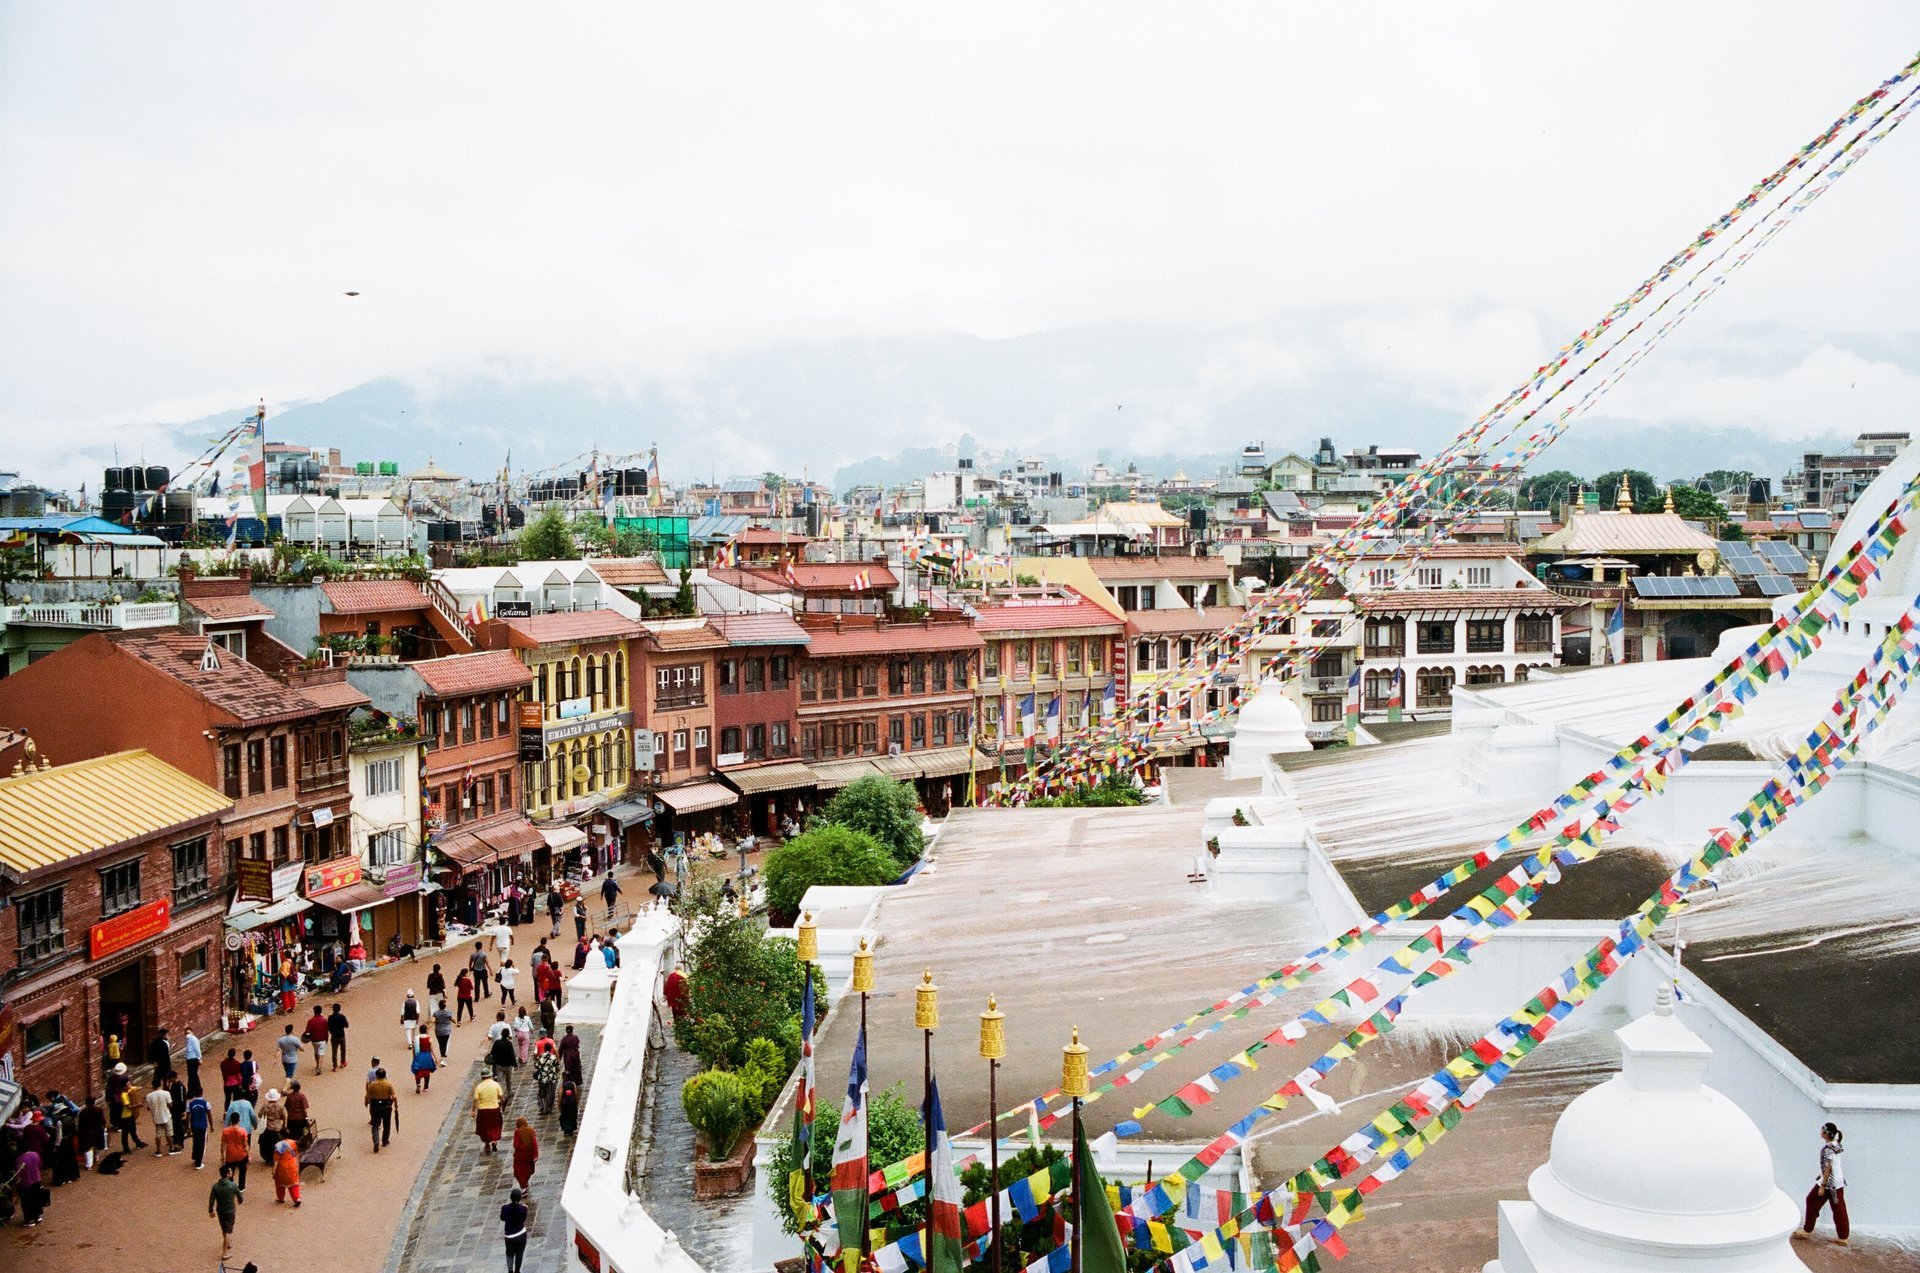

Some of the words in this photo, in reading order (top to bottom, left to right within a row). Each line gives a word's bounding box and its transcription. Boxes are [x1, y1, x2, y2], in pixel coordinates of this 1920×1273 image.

[500, 609, 529, 617] Gotama
[548, 726, 582, 740] HIMALAYAN
[584, 722, 597, 732] JAVA
[599, 718, 618, 729] COFFEE
